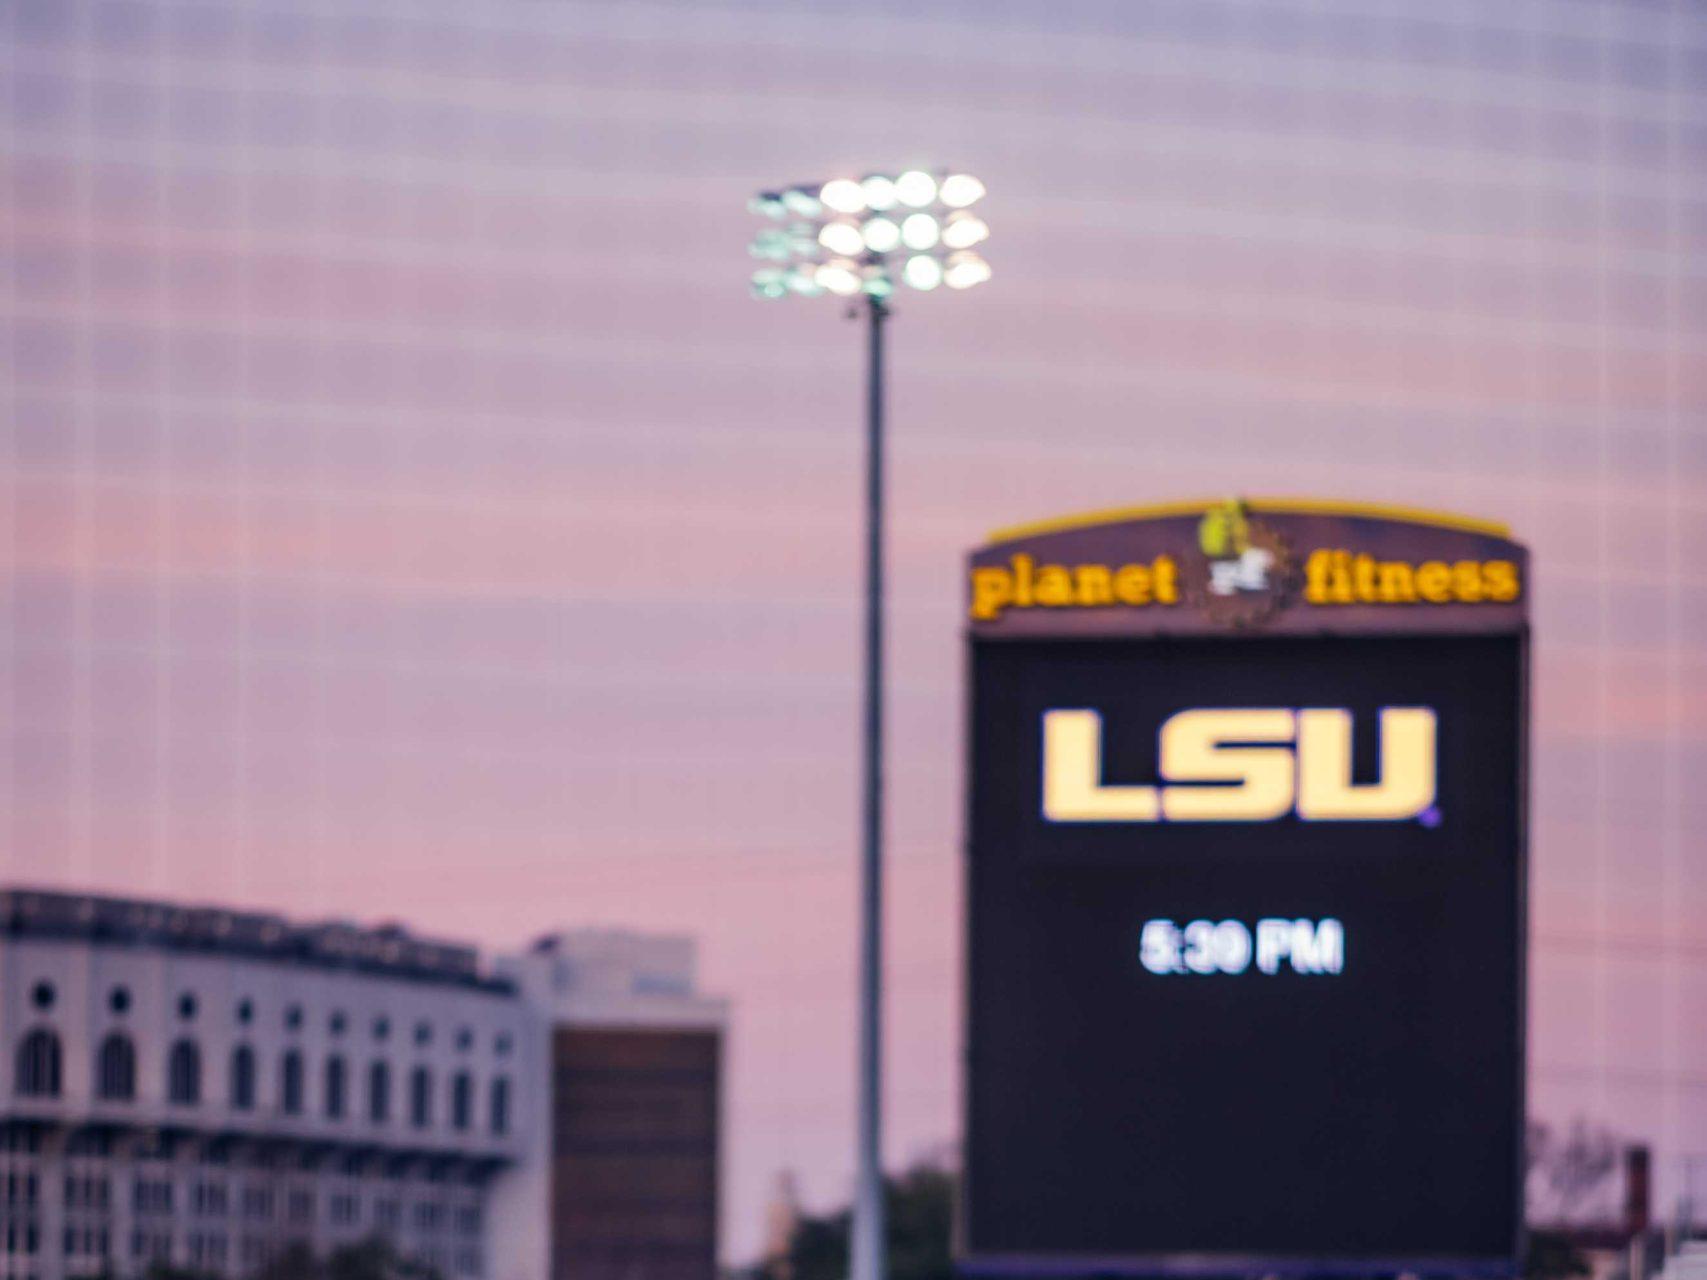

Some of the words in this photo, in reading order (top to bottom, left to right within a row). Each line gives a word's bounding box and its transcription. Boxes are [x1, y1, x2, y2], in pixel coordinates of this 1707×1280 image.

[970, 553, 1178, 620] planet
[1304, 549, 1520, 603] fitness
[1042, 707, 1437, 822] LSU
[1255, 917, 1344, 975] PM
